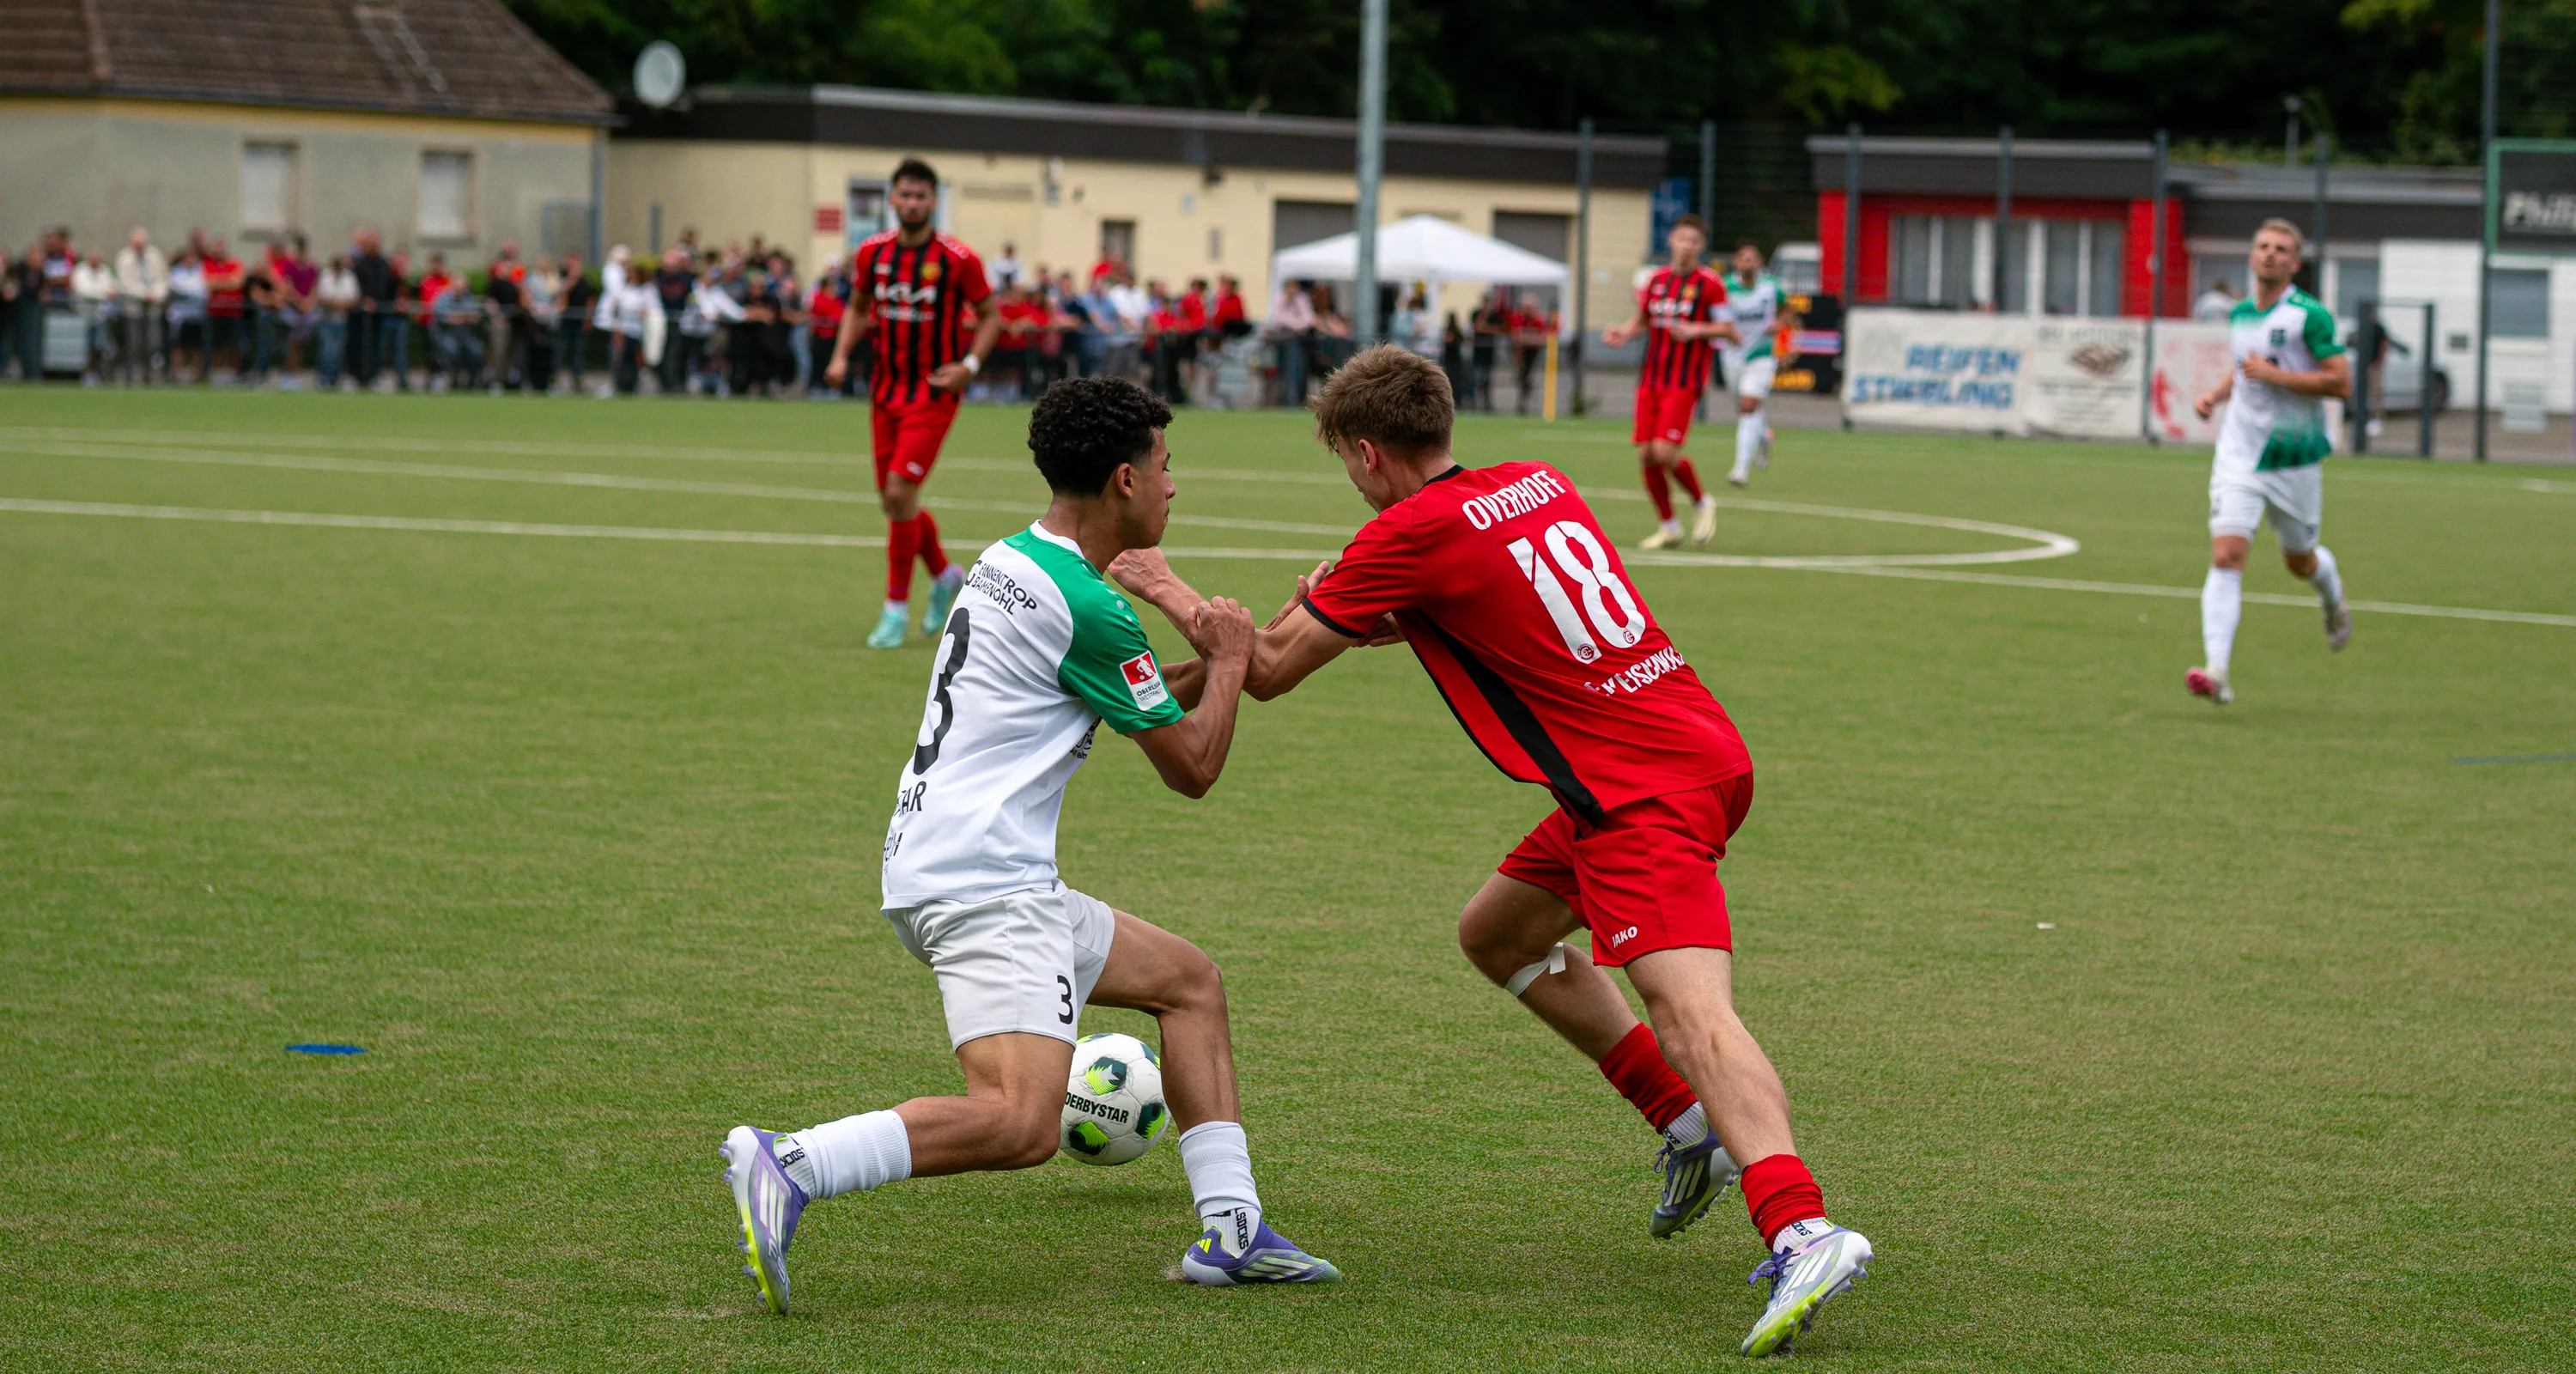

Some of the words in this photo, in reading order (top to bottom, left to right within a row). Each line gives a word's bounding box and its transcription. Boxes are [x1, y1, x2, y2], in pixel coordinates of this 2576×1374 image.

[1905, 344, 2021, 375] REIFEN
[1461, 470, 1566, 530] OVERHOFF
[971, 576, 1015, 616] BAMENOHL
[979, 563, 1037, 610] FINNENTROP
[1506, 520, 1646, 664] 18
[913, 607, 970, 775] 3
[1137, 681, 1161, 696] OBERLIGA
[1612, 926, 1638, 949] JAKO
[1057, 974, 1074, 1025] 3
[1065, 1091, 1129, 1124] DERBYSTAR
